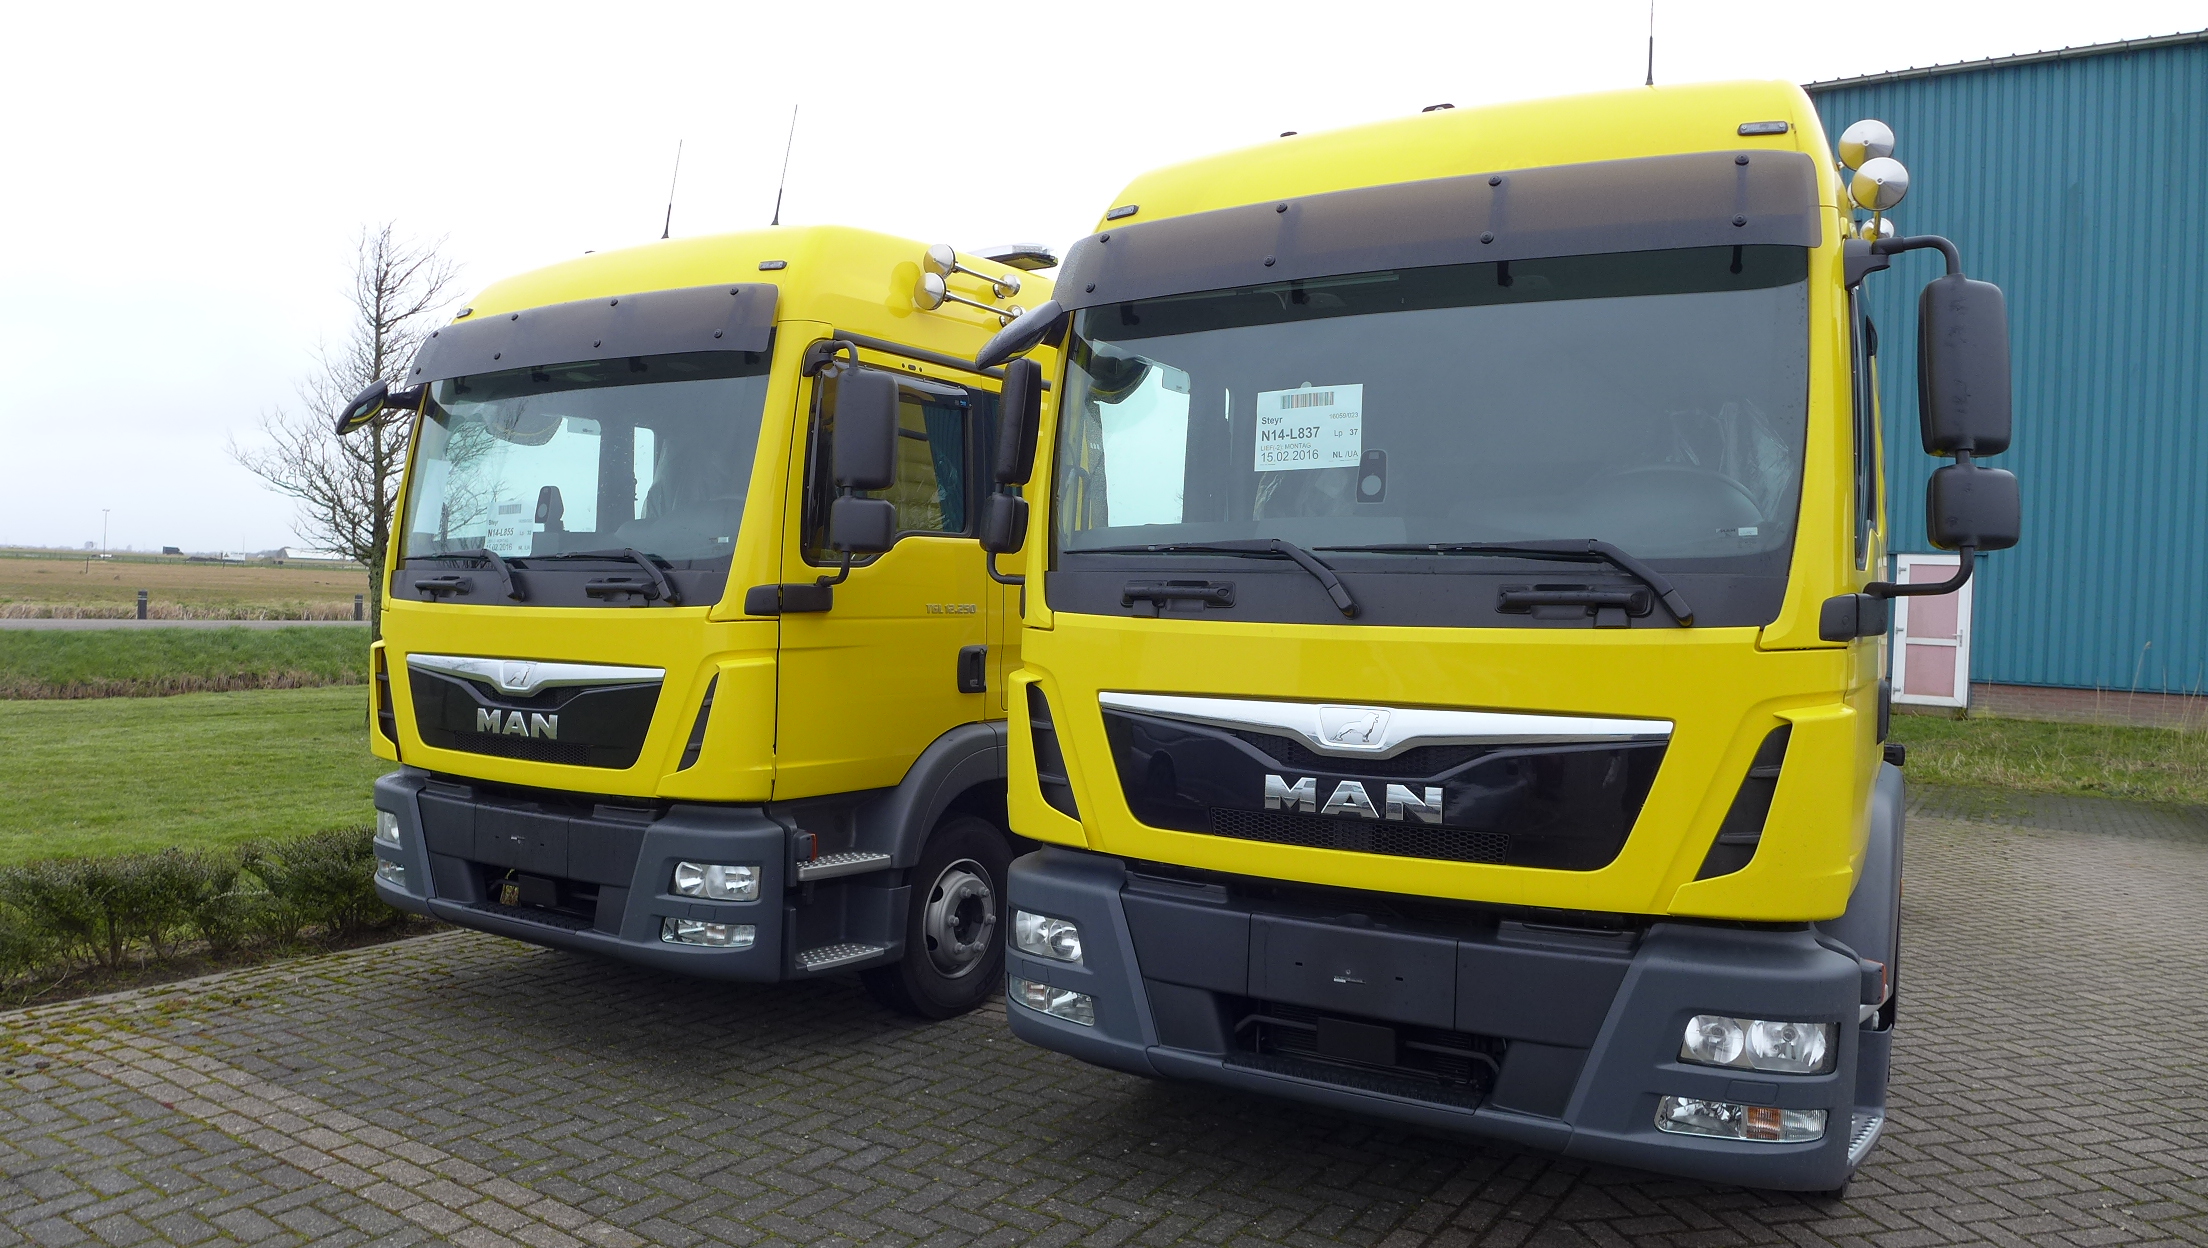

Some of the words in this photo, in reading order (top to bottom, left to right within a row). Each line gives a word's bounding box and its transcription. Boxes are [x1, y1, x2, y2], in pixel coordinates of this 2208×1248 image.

[1261, 416, 1283, 425] Steyr
[1261, 426, 1320, 441] N14-L837
[1349, 428, 1358, 436] 37
[1261, 449, 1319, 462] 15.02.2016
[1332, 451, 1343, 459] NL
[926, 603, 943, 614] TGL
[476, 707, 559, 740] MAN
[1264, 774, 1444, 825] MAN
